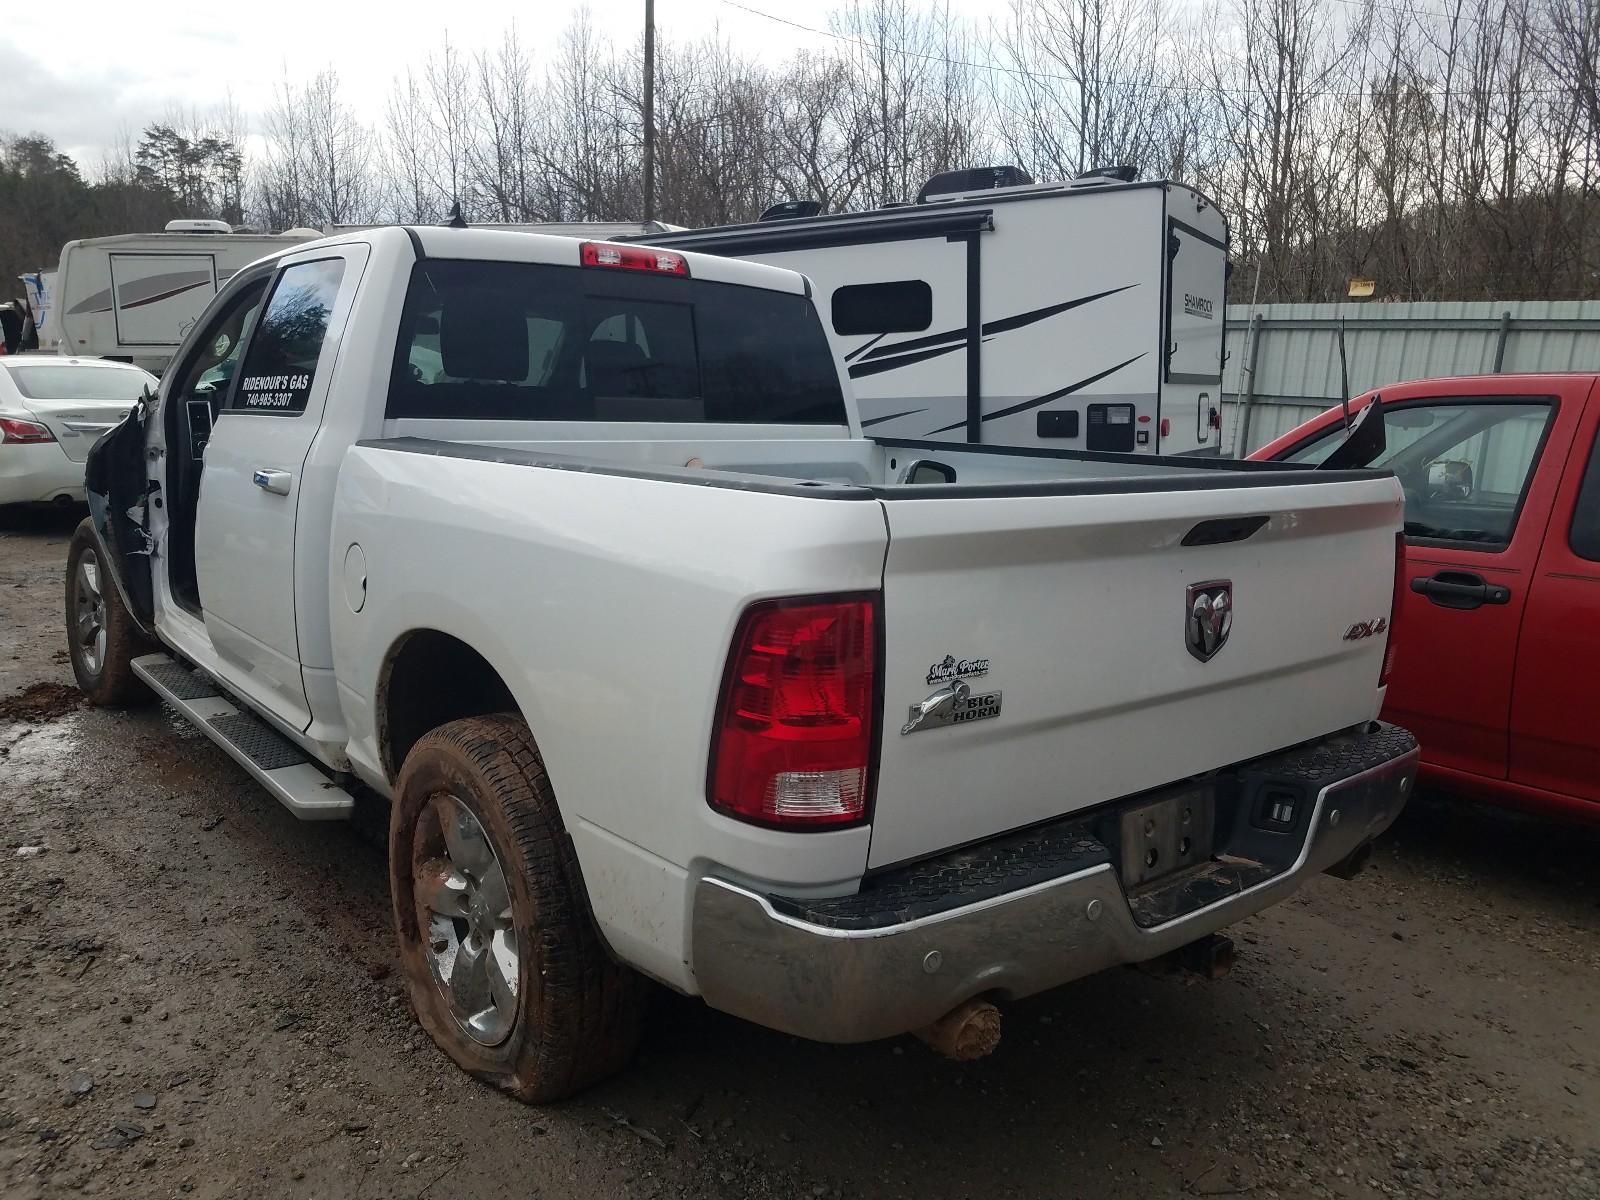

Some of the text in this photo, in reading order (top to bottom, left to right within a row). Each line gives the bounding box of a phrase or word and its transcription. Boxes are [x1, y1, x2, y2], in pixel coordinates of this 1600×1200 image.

[242, 374, 309, 391] RIDENOUR'S GAS
[246, 392, 292, 406] 740-985-3307
[931, 660, 990, 678] Mark Porter
[967, 695, 995, 709] BIG
[953, 705, 1000, 722] HORN
